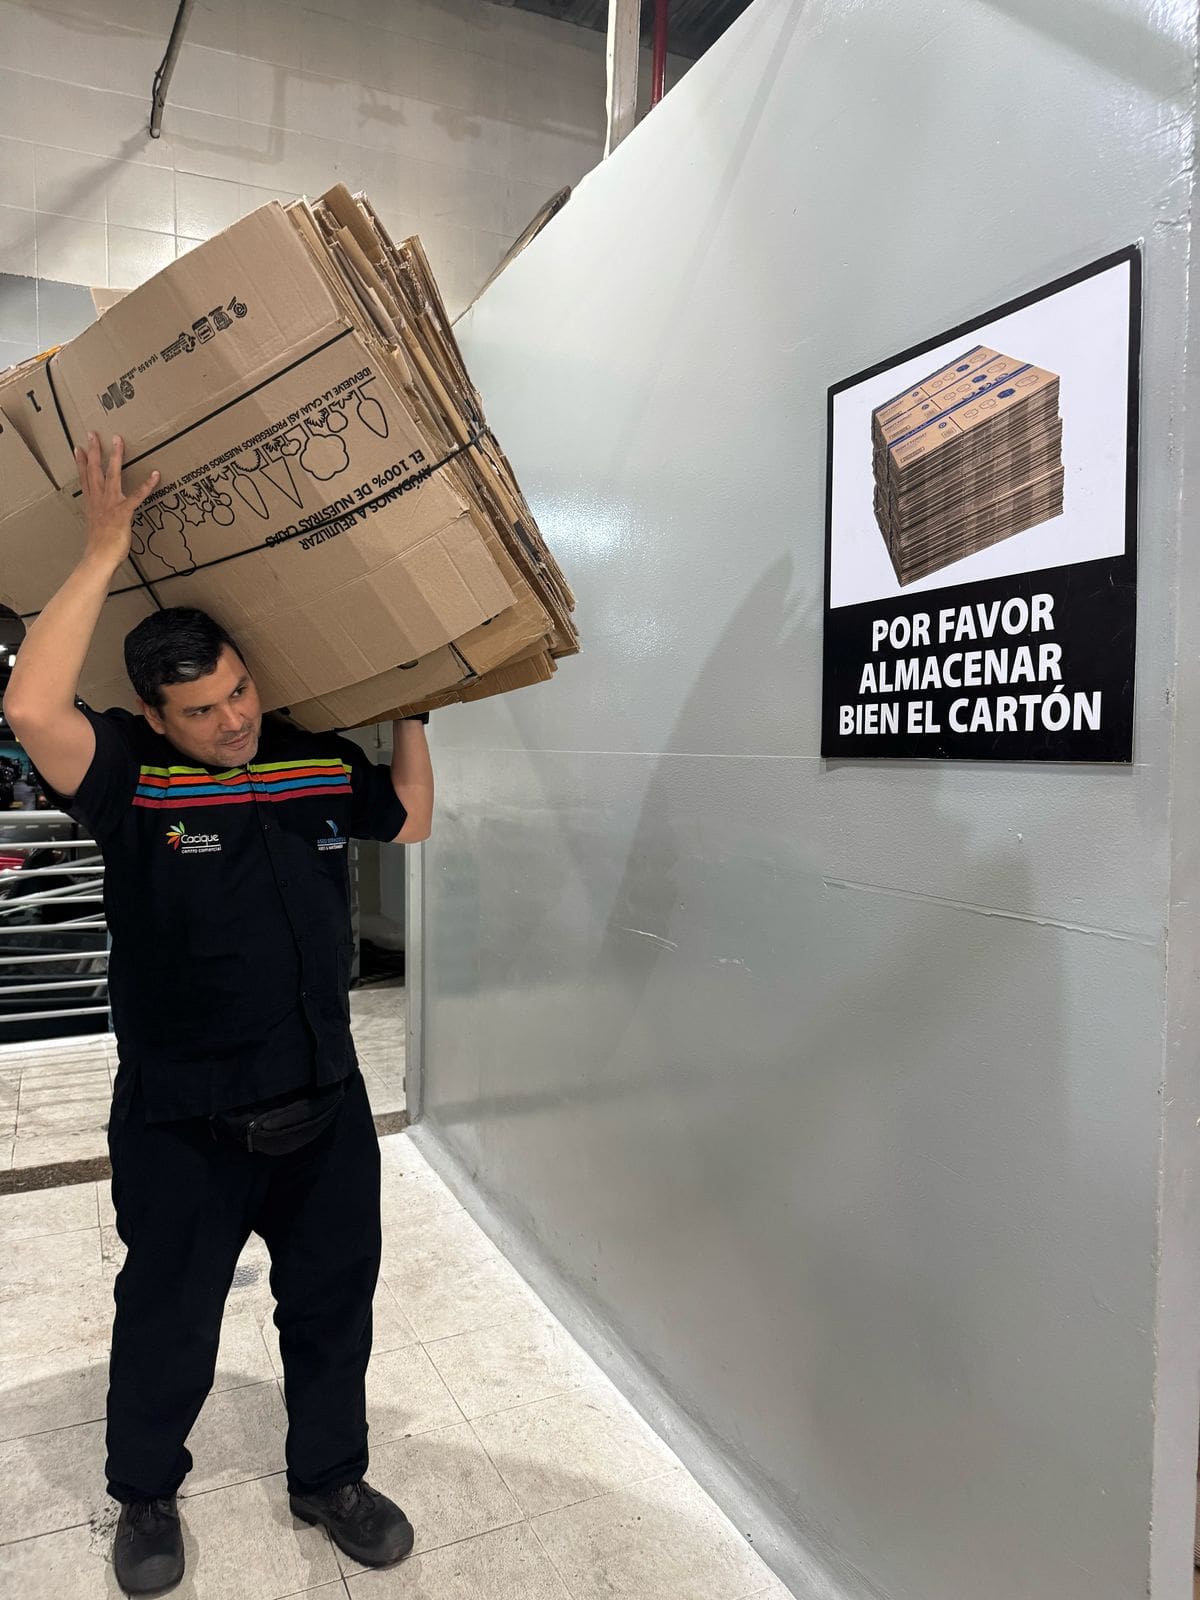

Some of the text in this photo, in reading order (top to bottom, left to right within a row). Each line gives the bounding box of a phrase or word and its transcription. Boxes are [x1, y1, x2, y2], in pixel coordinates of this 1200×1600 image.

[321, 390, 333, 401] LA
[286, 410, 299, 426] ASÍ
[241, 418, 288, 450] PROTEGEMOS
[208, 444, 243, 468] NUESTROS
[408, 448, 425, 465] EL
[176, 479, 183, 487] Y
[180, 463, 211, 484] BOSQUES
[370, 459, 409, 489] 100%
[353, 482, 372, 500] DE
[297, 494, 355, 531] NUESTRAS
[355, 506, 368, 519] A
[298, 513, 357, 551] REUTILIZAR
[872, 593, 1055, 652] POR FAVOR
[858, 642, 1062, 695] ALMACENAR
[839, 684, 1102, 736] BIEN EL CARTÓN
[181, 834, 219, 847] Cacique
